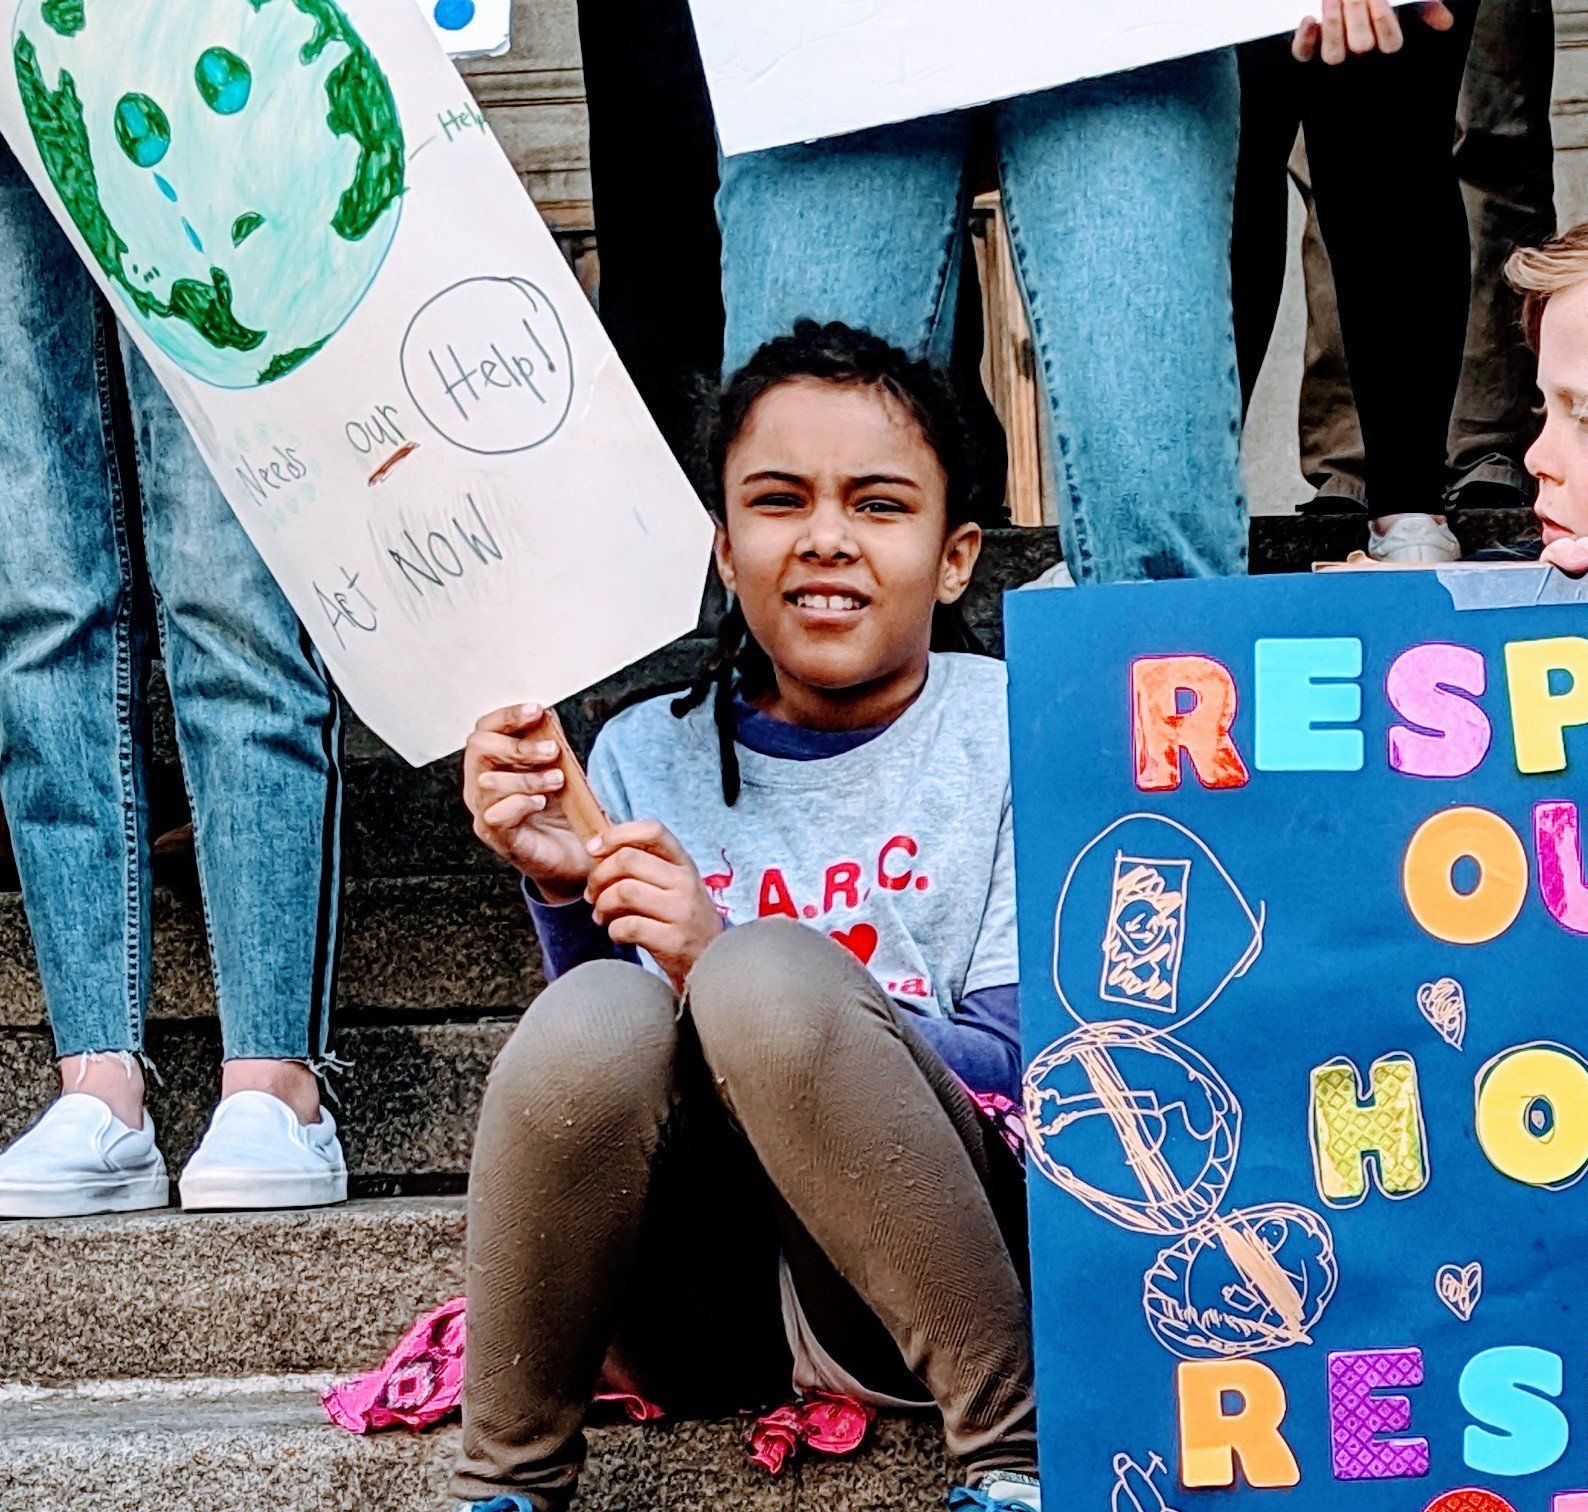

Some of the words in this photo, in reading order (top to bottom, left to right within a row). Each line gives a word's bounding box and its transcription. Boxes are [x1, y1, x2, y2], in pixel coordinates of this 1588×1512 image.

[235, 446, 308, 507] Needs
[345, 405, 407, 454] our
[428, 318, 556, 421] Help!
[387, 491, 503, 597] NOW
